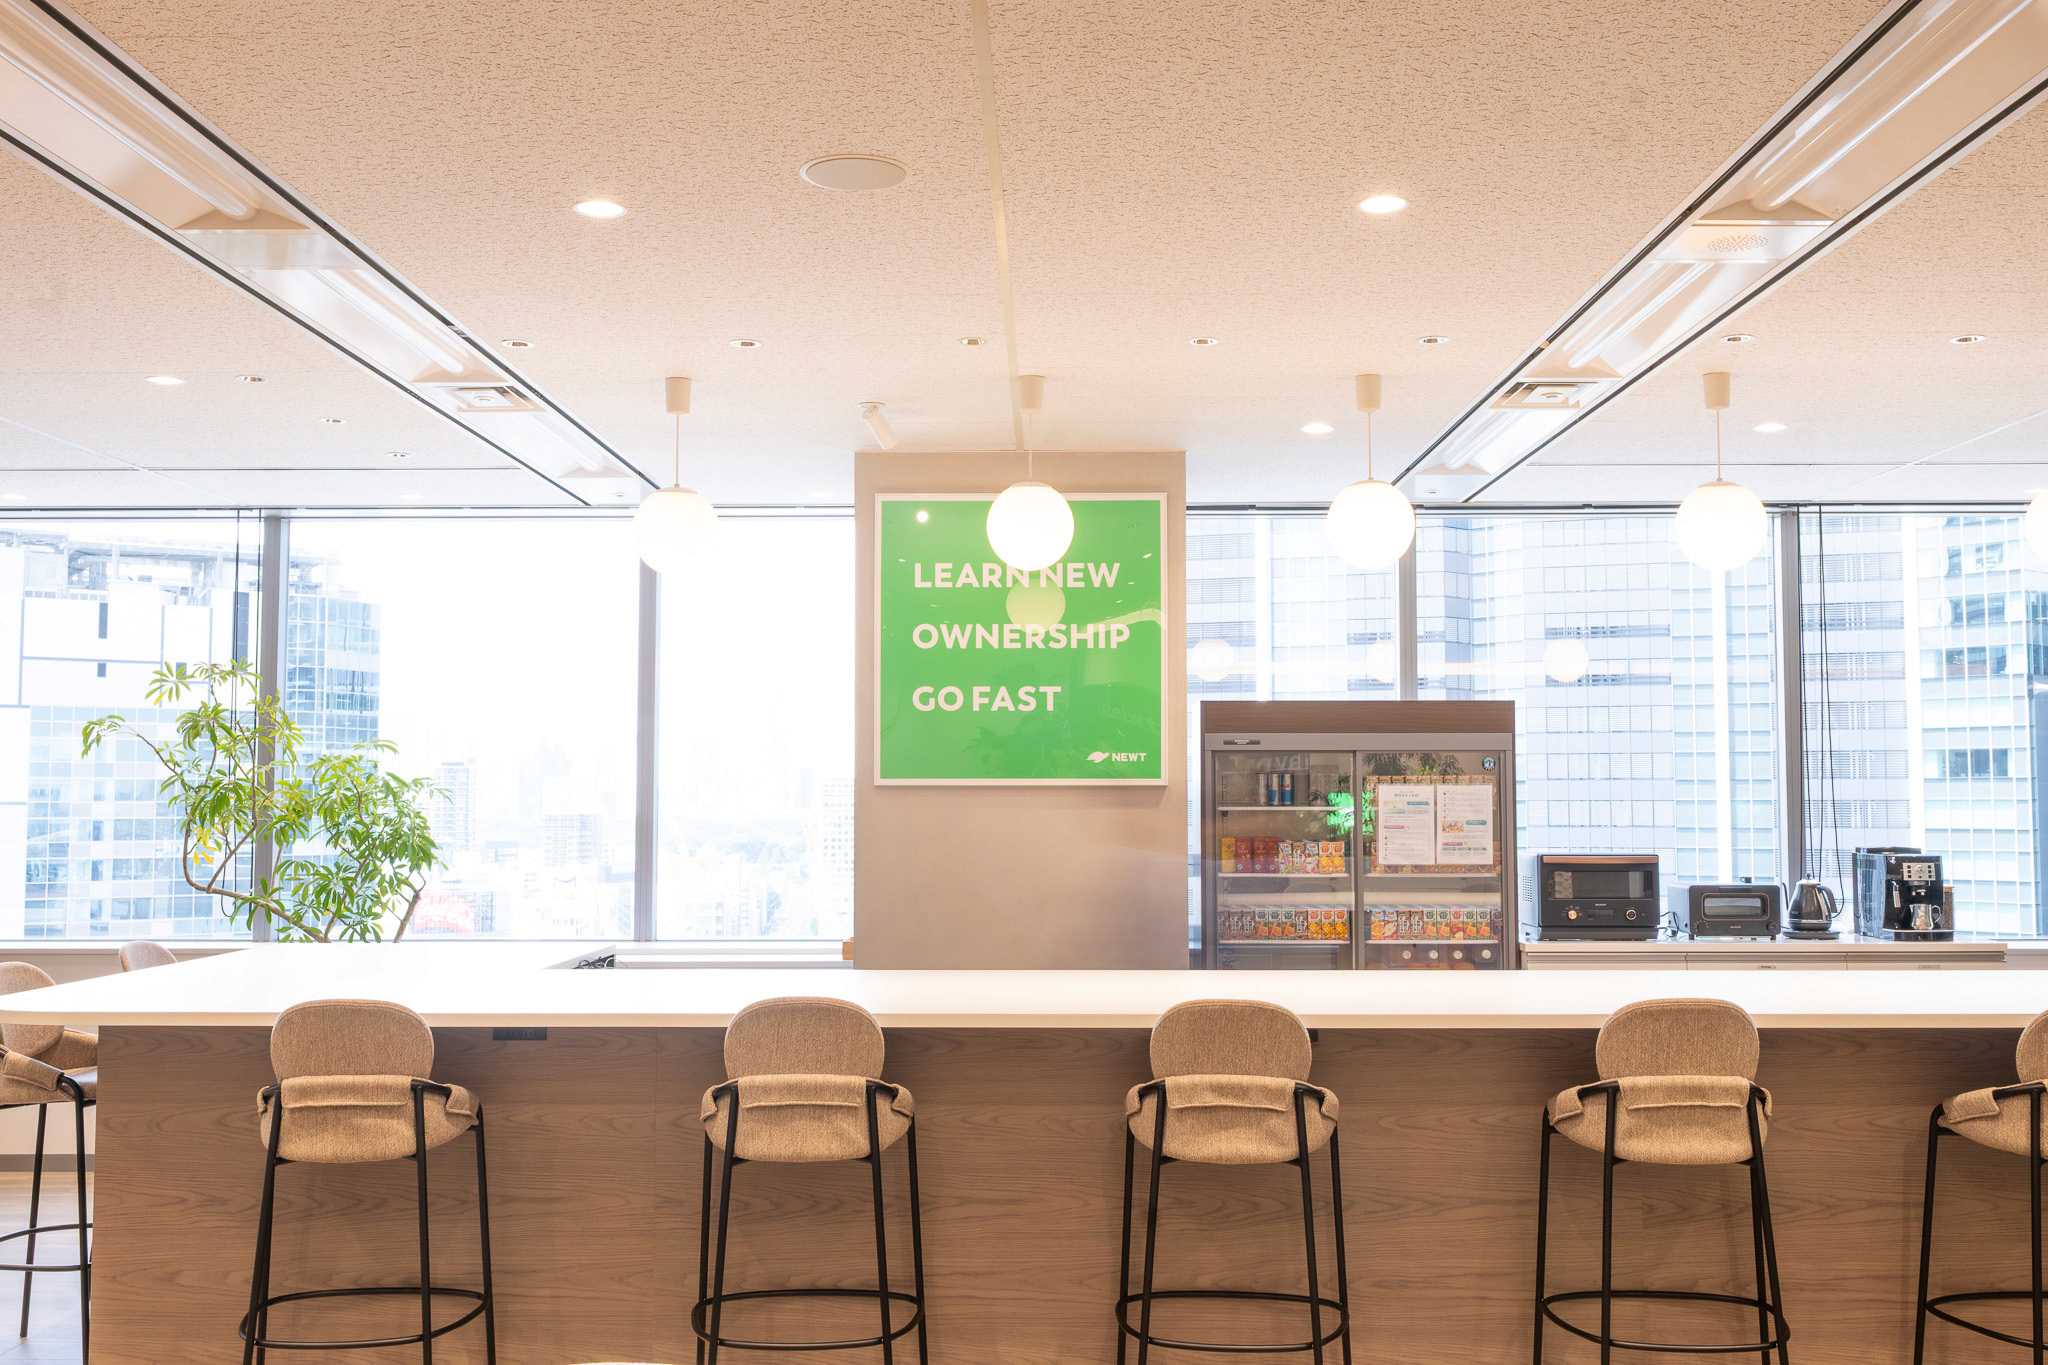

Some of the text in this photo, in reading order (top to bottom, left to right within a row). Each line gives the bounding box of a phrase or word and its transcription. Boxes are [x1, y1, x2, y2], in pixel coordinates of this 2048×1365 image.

[914, 562, 1120, 588] LEARN NEW
[912, 623, 1130, 649] OWNERSHIP
[912, 686, 1061, 711] GO FAST
[1111, 752, 1147, 761] NEWT
